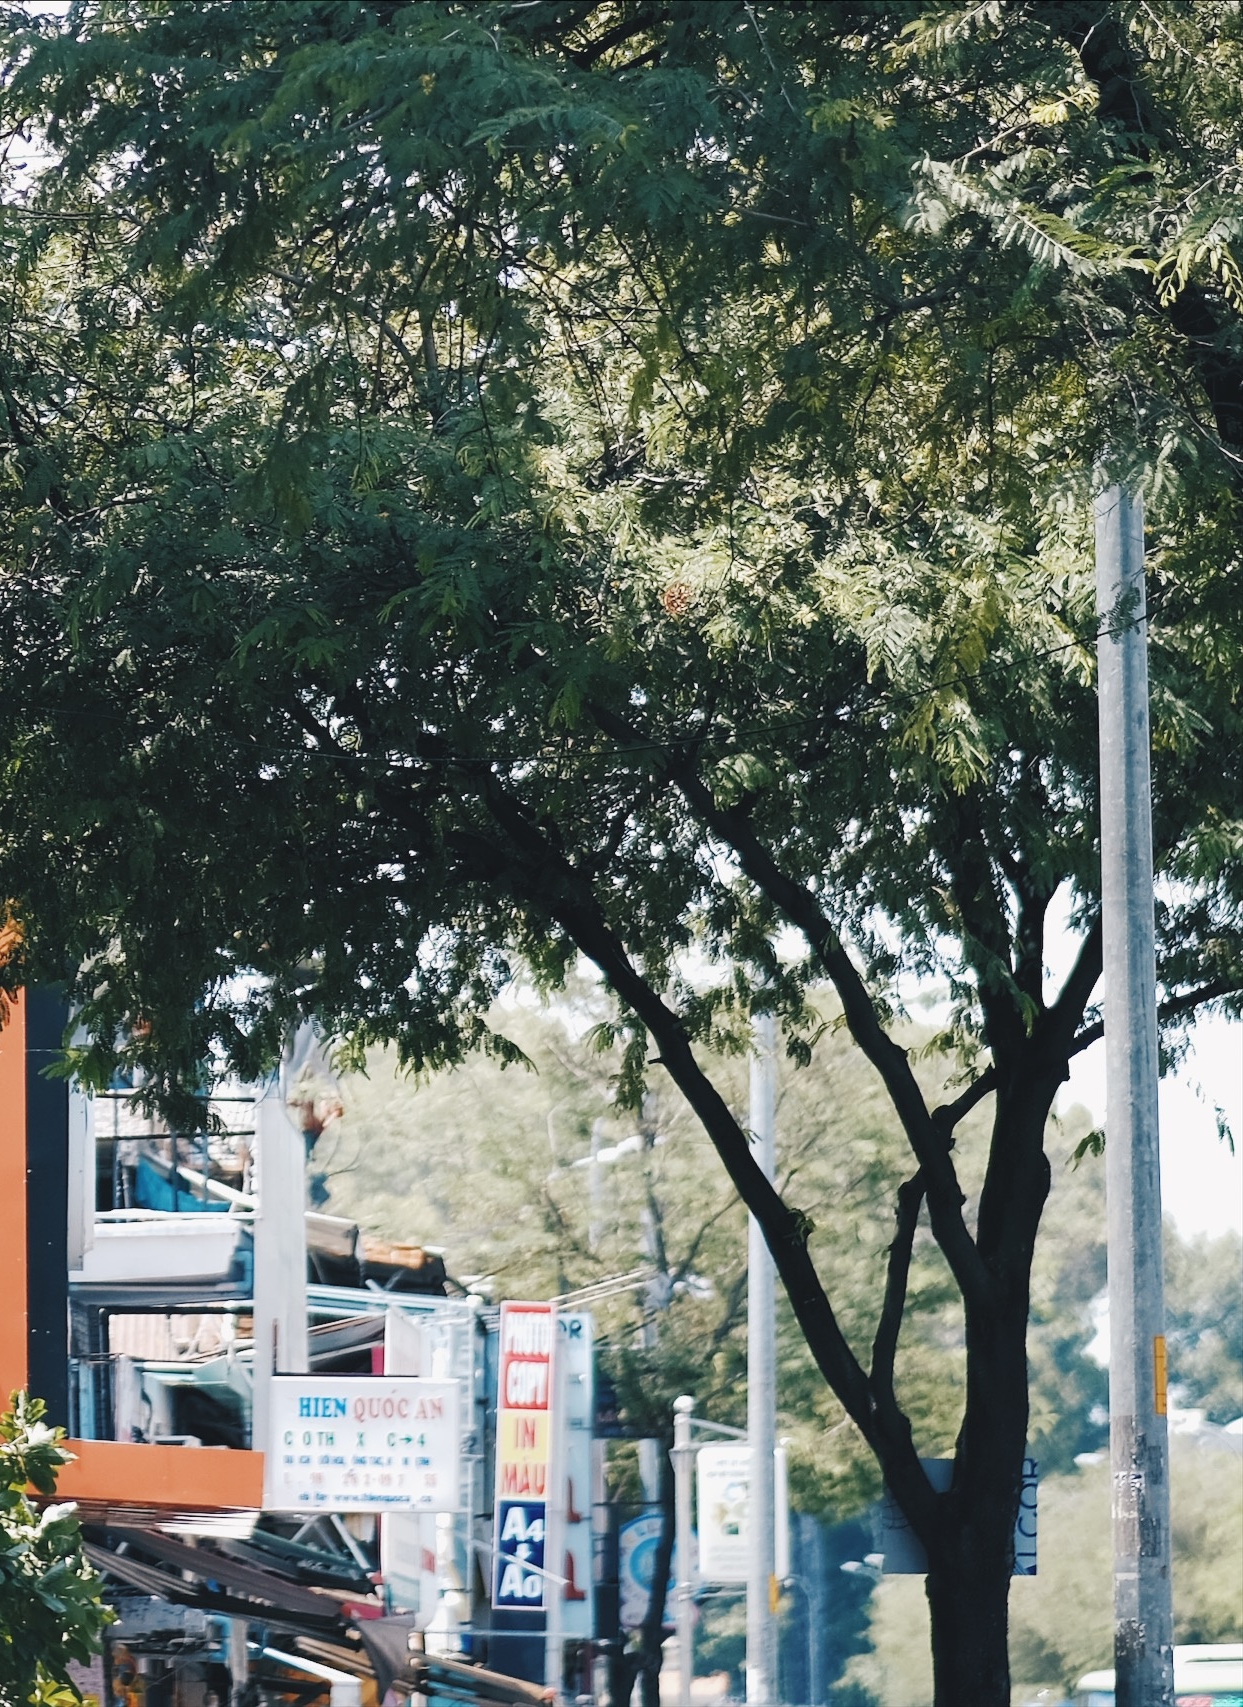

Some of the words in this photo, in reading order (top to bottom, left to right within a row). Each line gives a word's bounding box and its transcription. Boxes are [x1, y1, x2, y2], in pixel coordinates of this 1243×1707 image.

[506, 1361, 548, 1406] COPY
[515, 1417, 536, 1448] IN
[501, 1506, 544, 1542] A4
